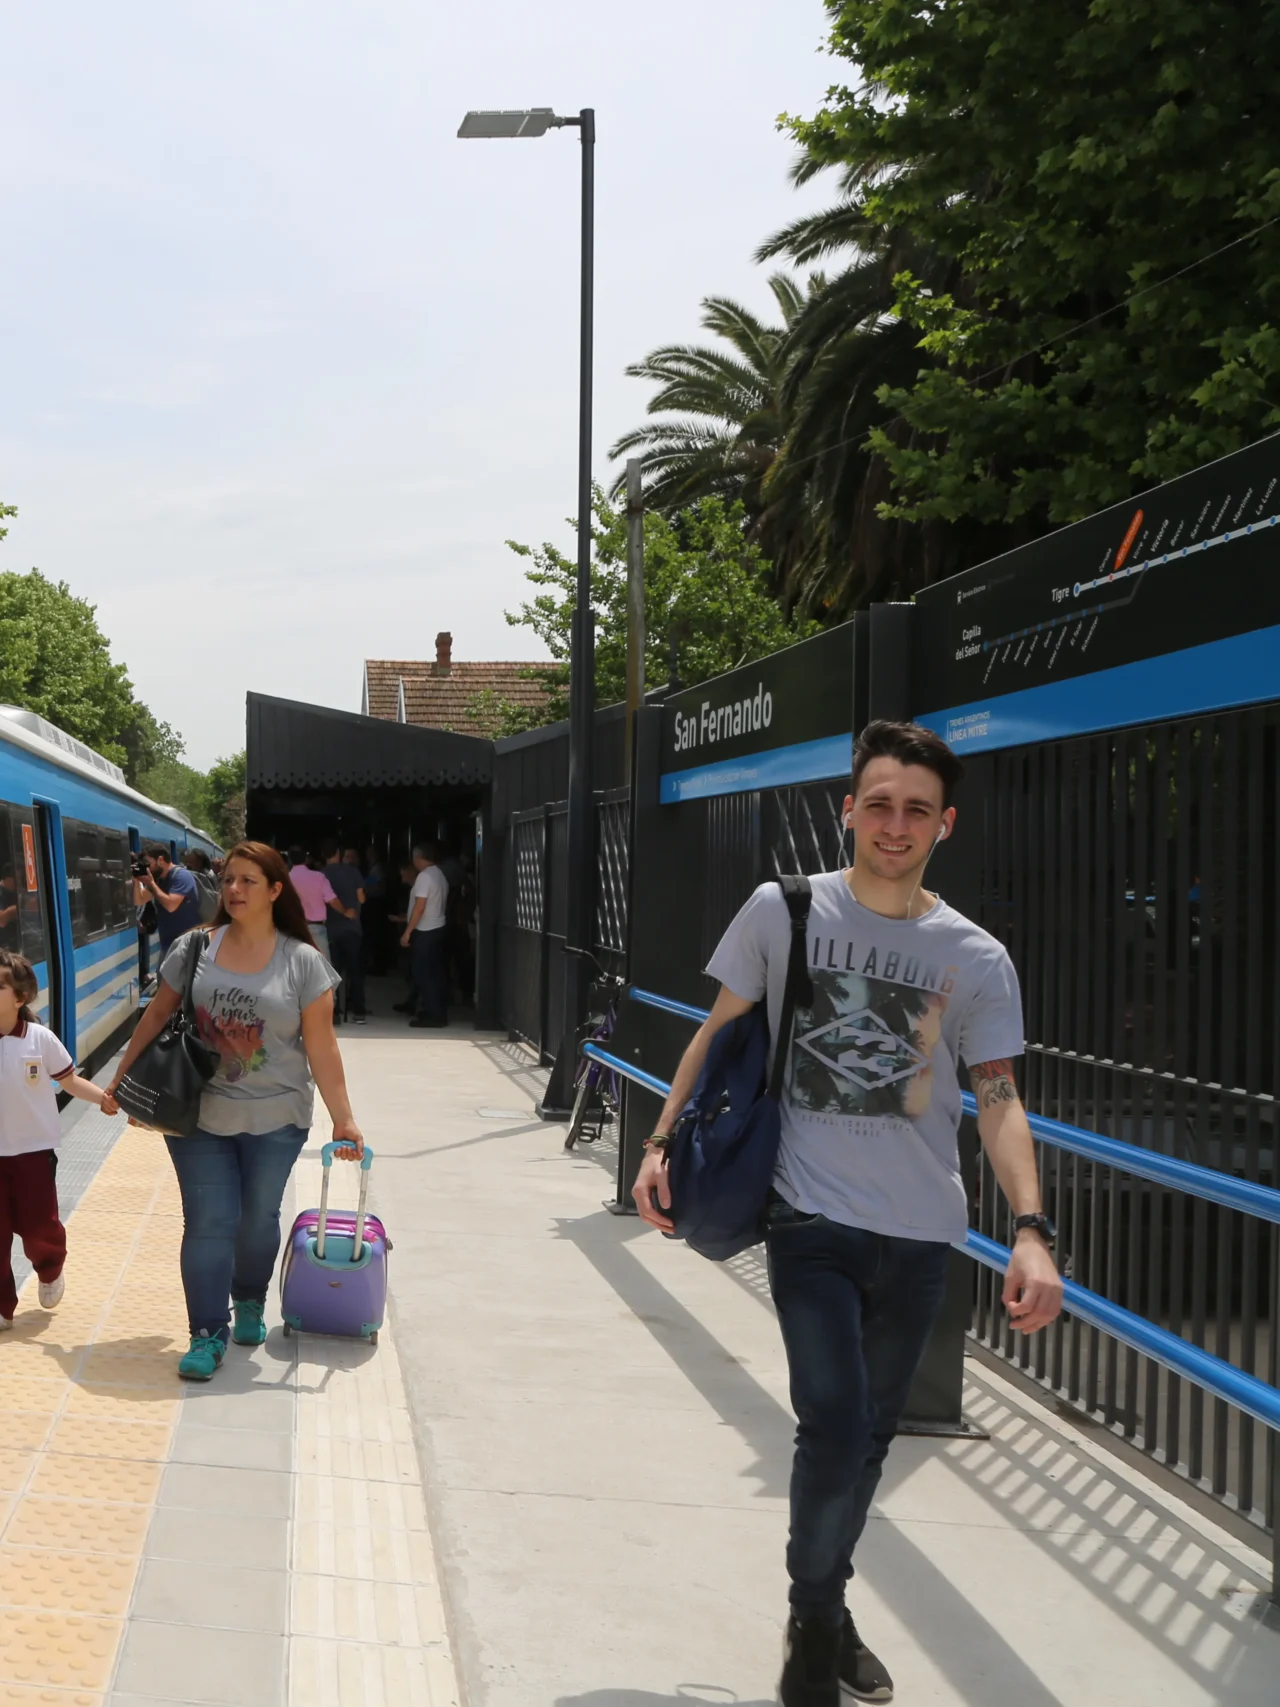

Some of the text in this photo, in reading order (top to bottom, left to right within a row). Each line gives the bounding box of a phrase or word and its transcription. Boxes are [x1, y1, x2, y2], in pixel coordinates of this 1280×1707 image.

[1150, 519, 1169, 552] Victoria
[1052, 587, 1070, 602] Tigre
[962, 625, 982, 641] Capilla
[955, 643, 982, 661] del Señor
[674, 682, 772, 752] San Fernando
[968, 723, 988, 739] MITRE
